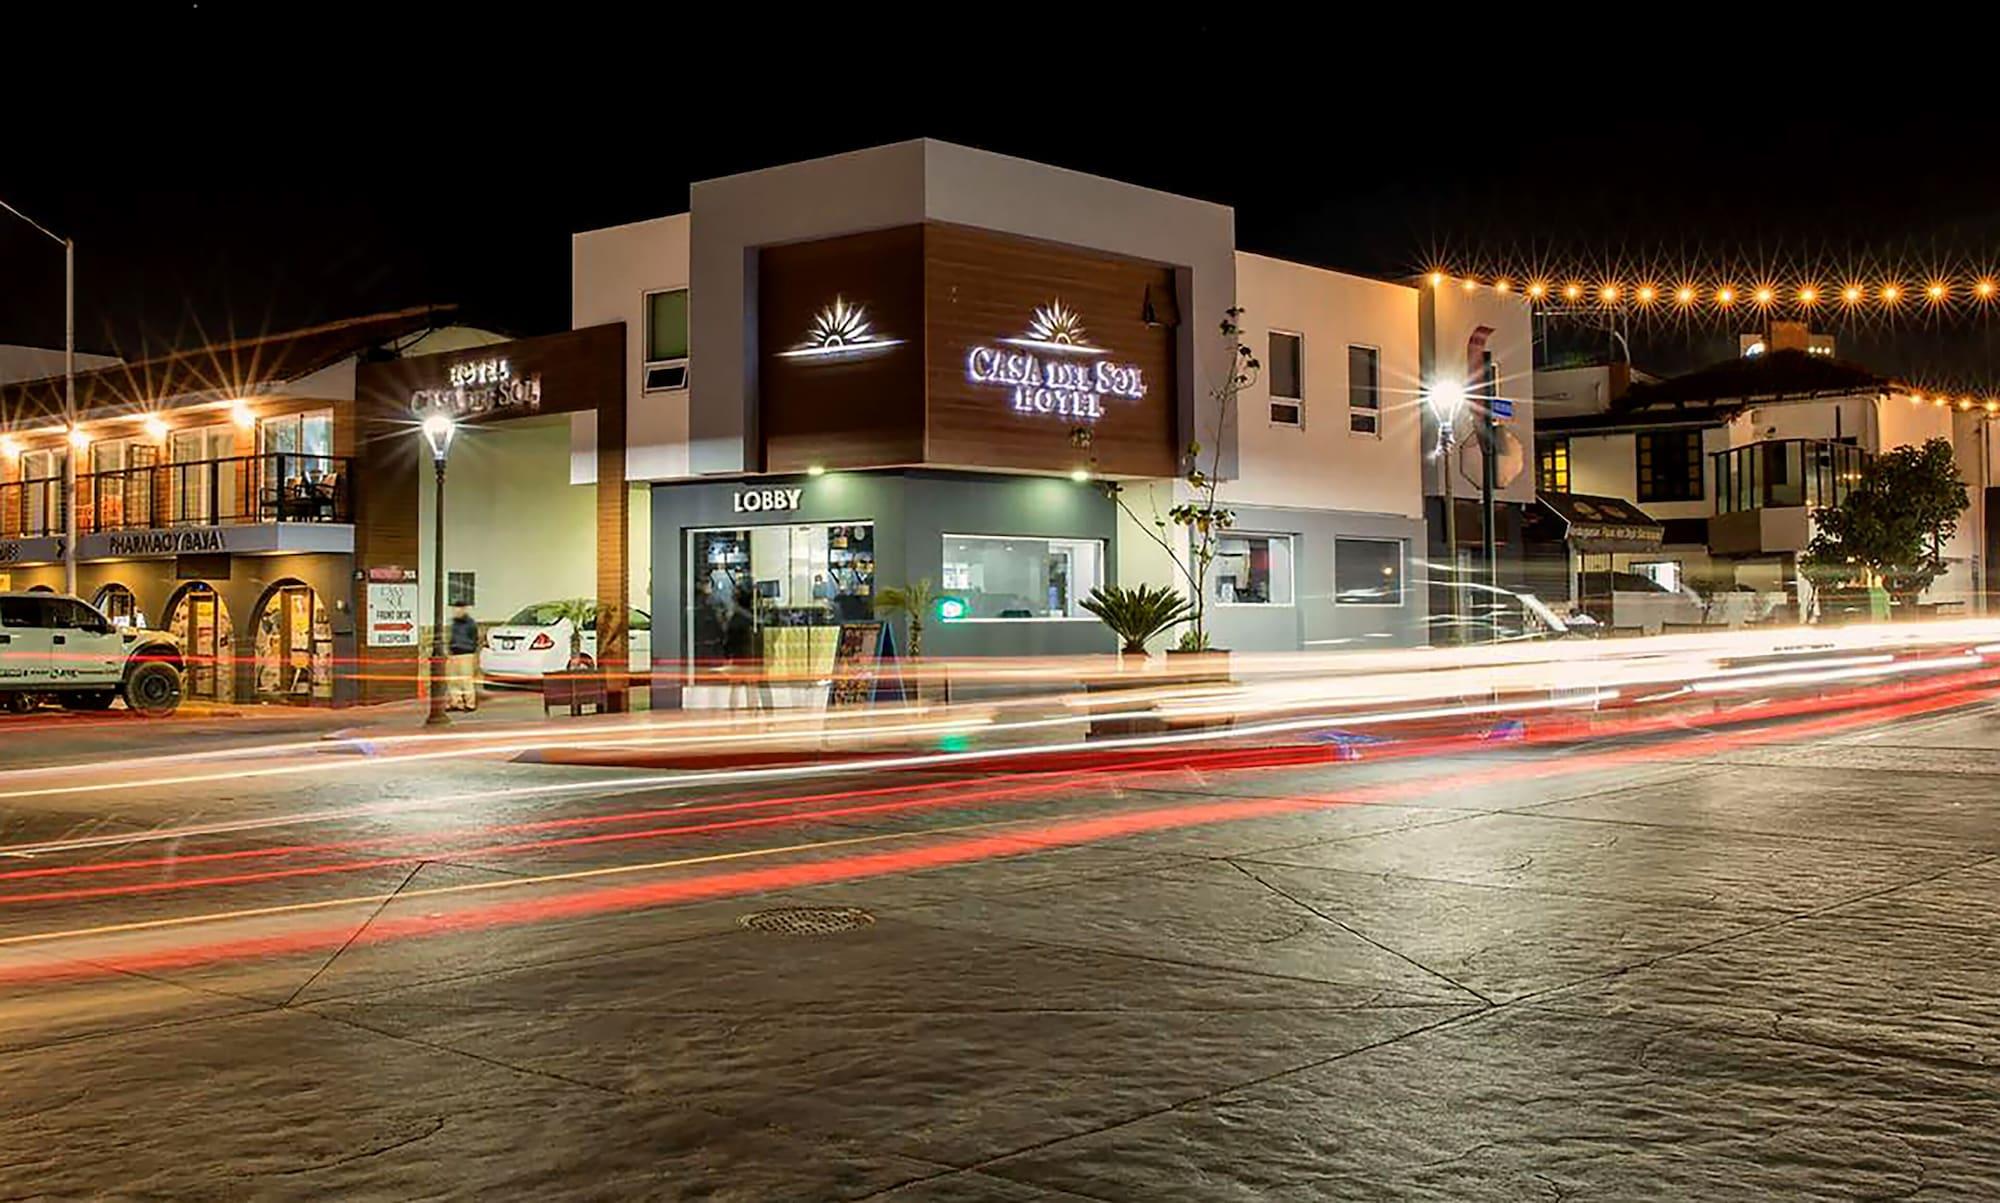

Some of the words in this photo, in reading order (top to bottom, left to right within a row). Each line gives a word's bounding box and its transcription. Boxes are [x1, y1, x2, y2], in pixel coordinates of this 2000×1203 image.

[968, 346, 1043, 386] CASA
[1046, 362, 1092, 392] DEL
[1095, 361, 1147, 399] SOL
[1014, 386, 1104, 417] HOTEL
[733, 488, 803, 513] LOBBY
